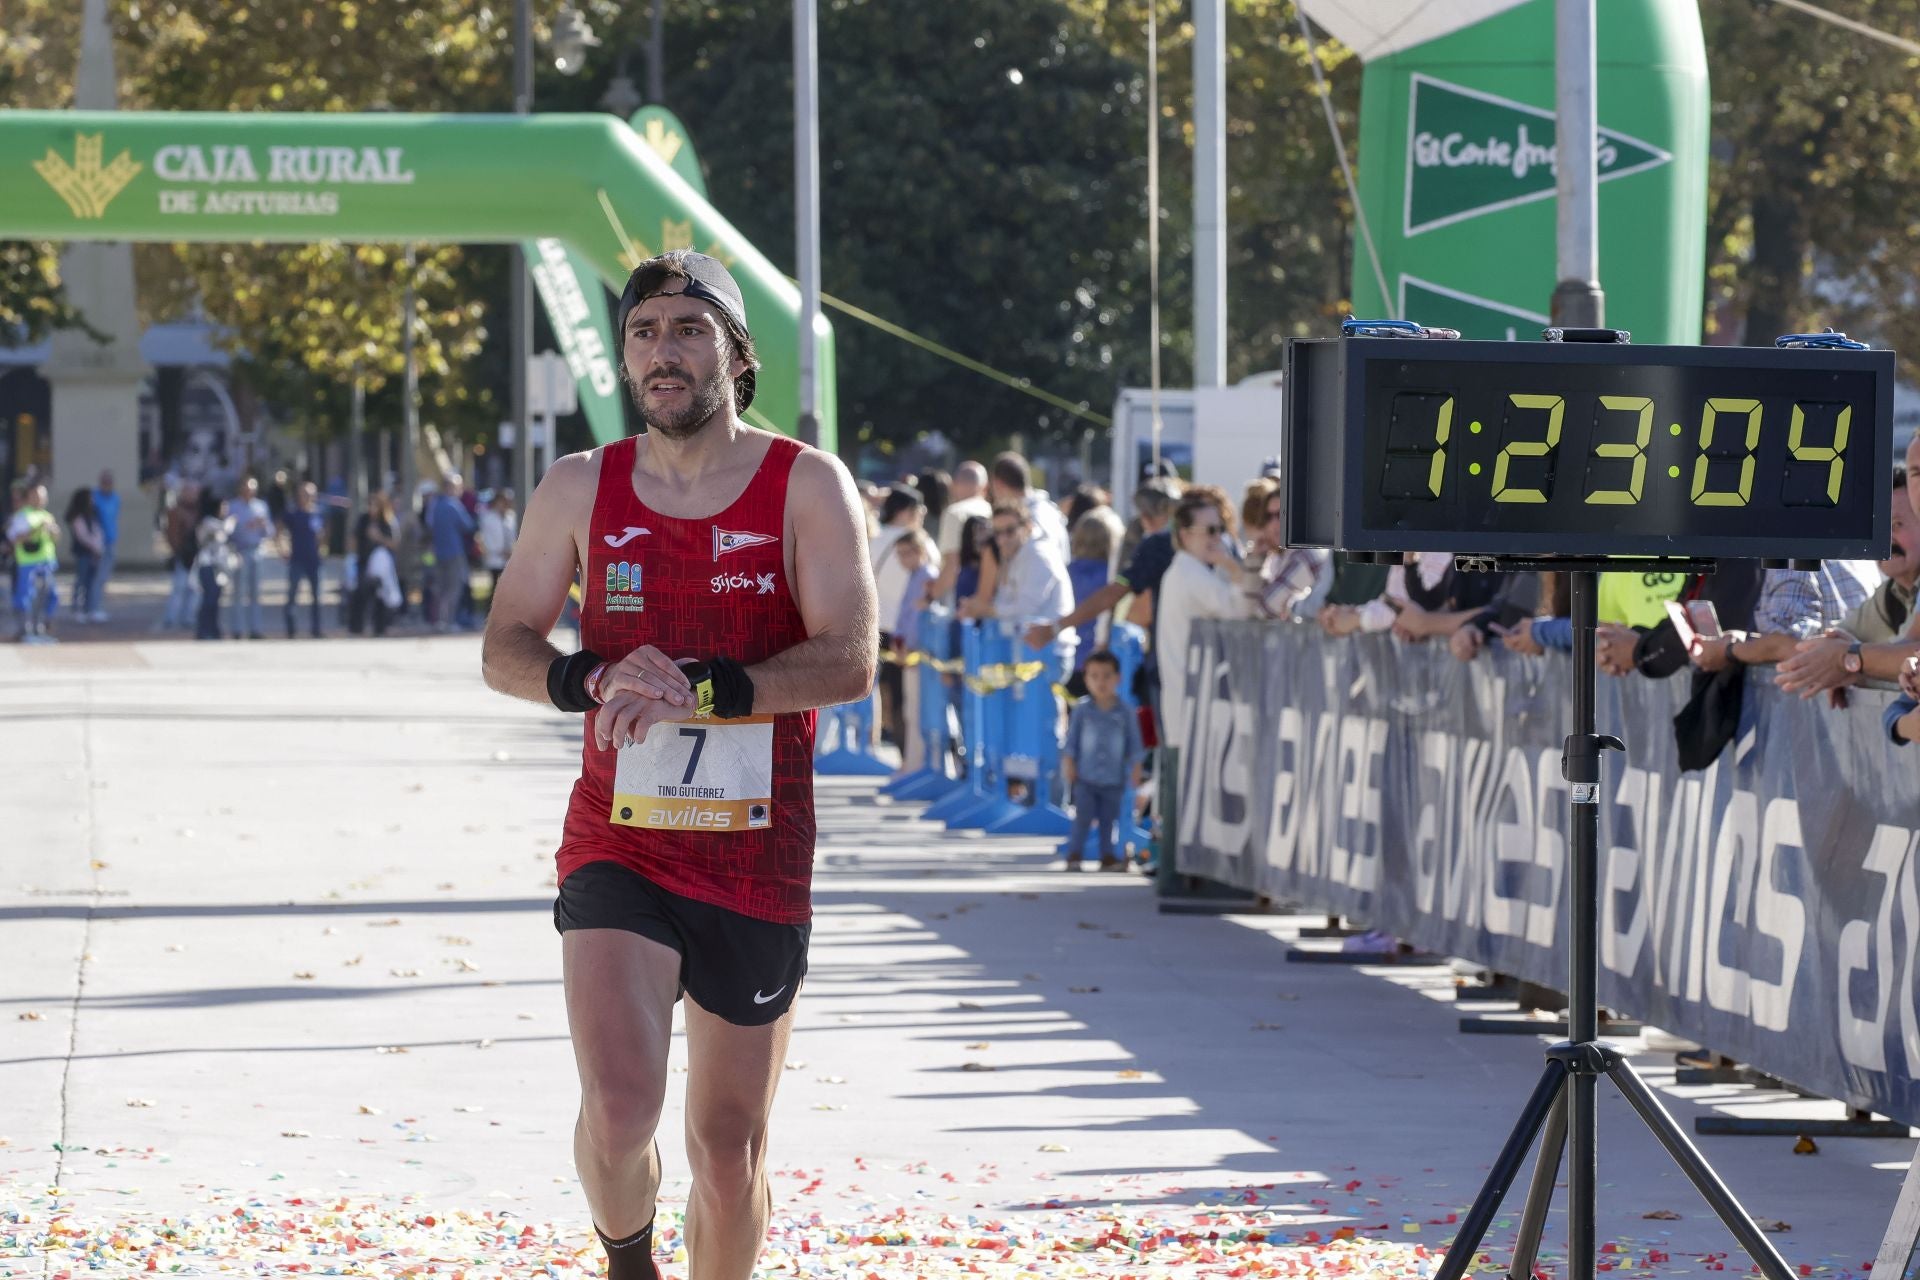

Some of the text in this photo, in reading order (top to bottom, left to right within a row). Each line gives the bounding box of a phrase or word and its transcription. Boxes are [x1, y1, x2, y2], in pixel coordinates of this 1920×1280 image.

[153, 145, 415, 184] CAJA RURAL
[158, 191, 339, 215] DE ASTURIAS
[1428, 394, 1852, 506] 1:23:04
[710, 571, 754, 594] gijón
[679, 728, 707, 784] 7
[658, 784, 725, 799] TINO GUTIÉRREZ
[648, 806, 733, 828] avilés
